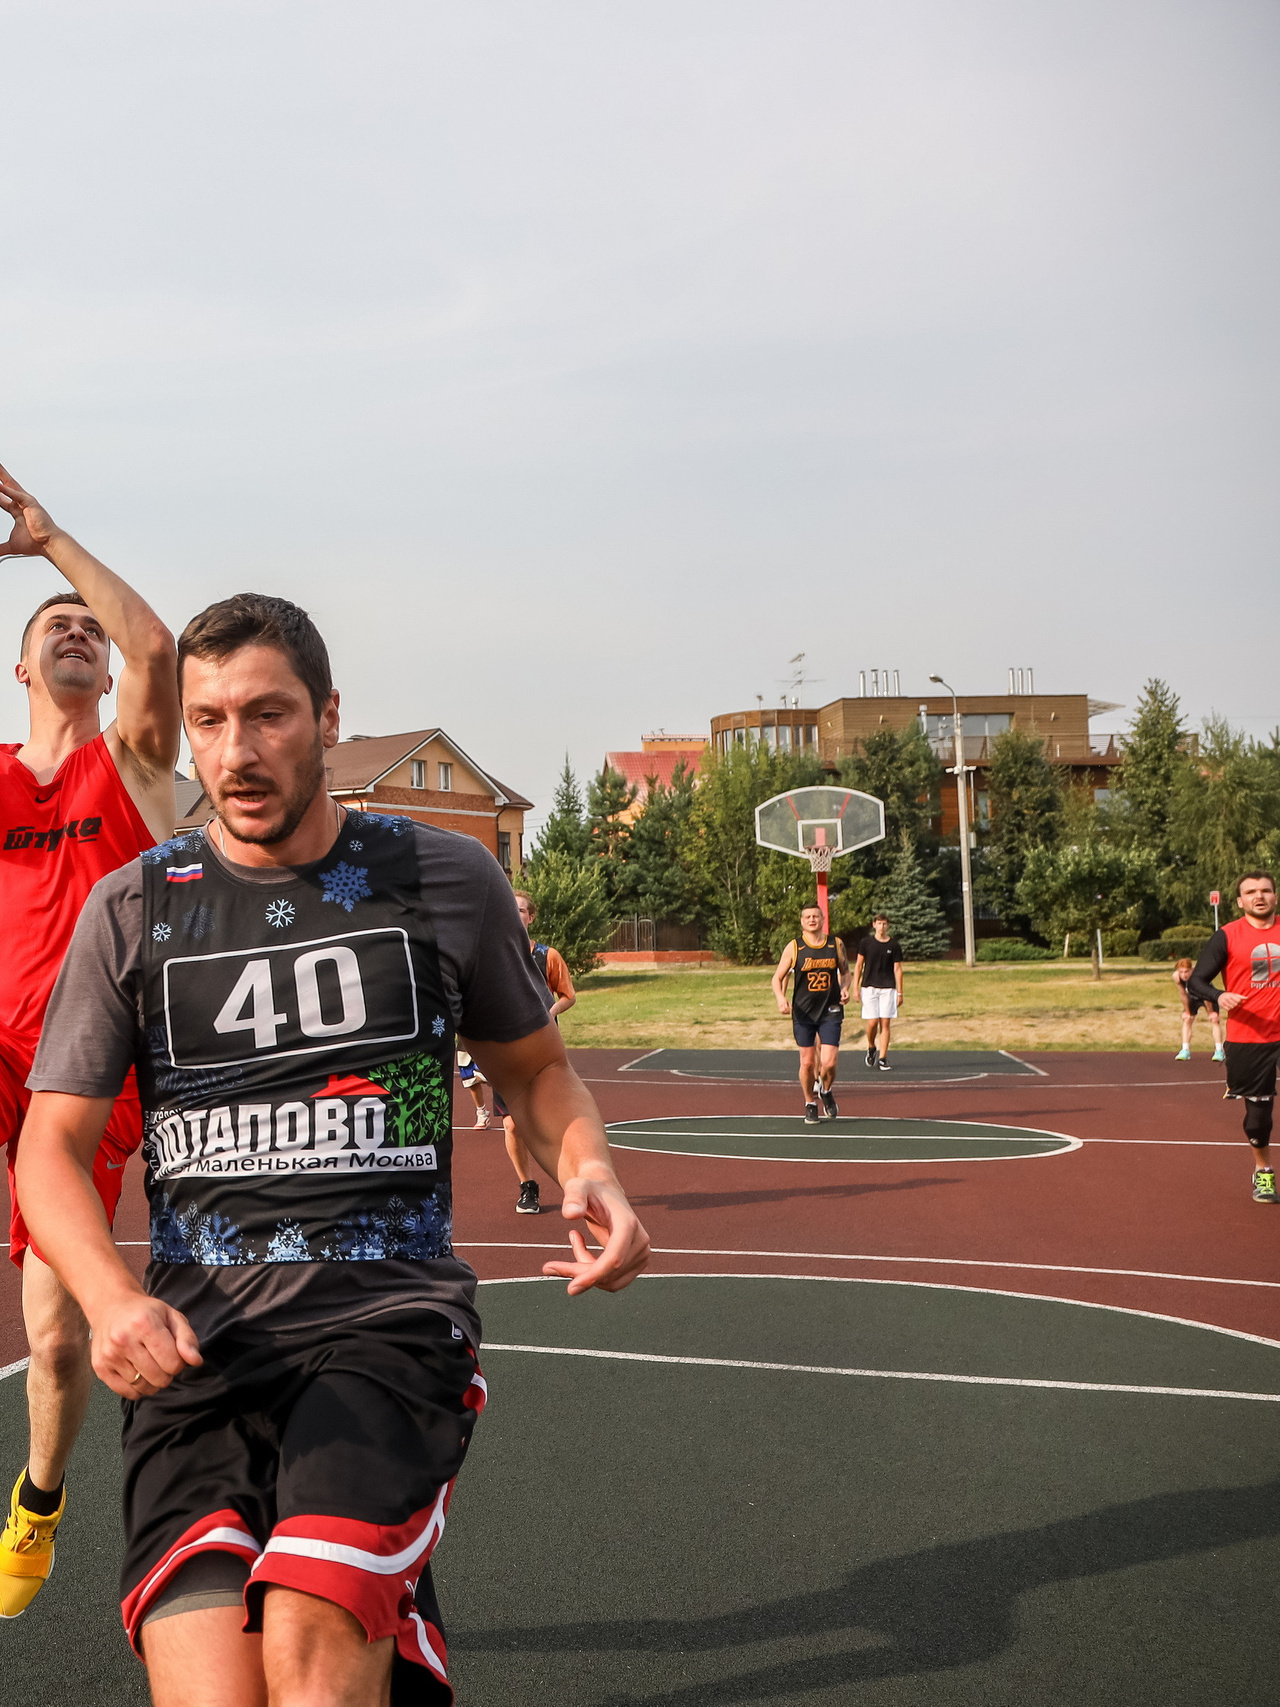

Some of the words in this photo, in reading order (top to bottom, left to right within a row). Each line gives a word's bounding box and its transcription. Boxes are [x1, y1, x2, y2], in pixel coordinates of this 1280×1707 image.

[808, 972, 830, 991] 23
[213, 945, 366, 1047] 40
[195, 1153, 338, 1172] маленькая
[349, 1152, 433, 1169] Москва
